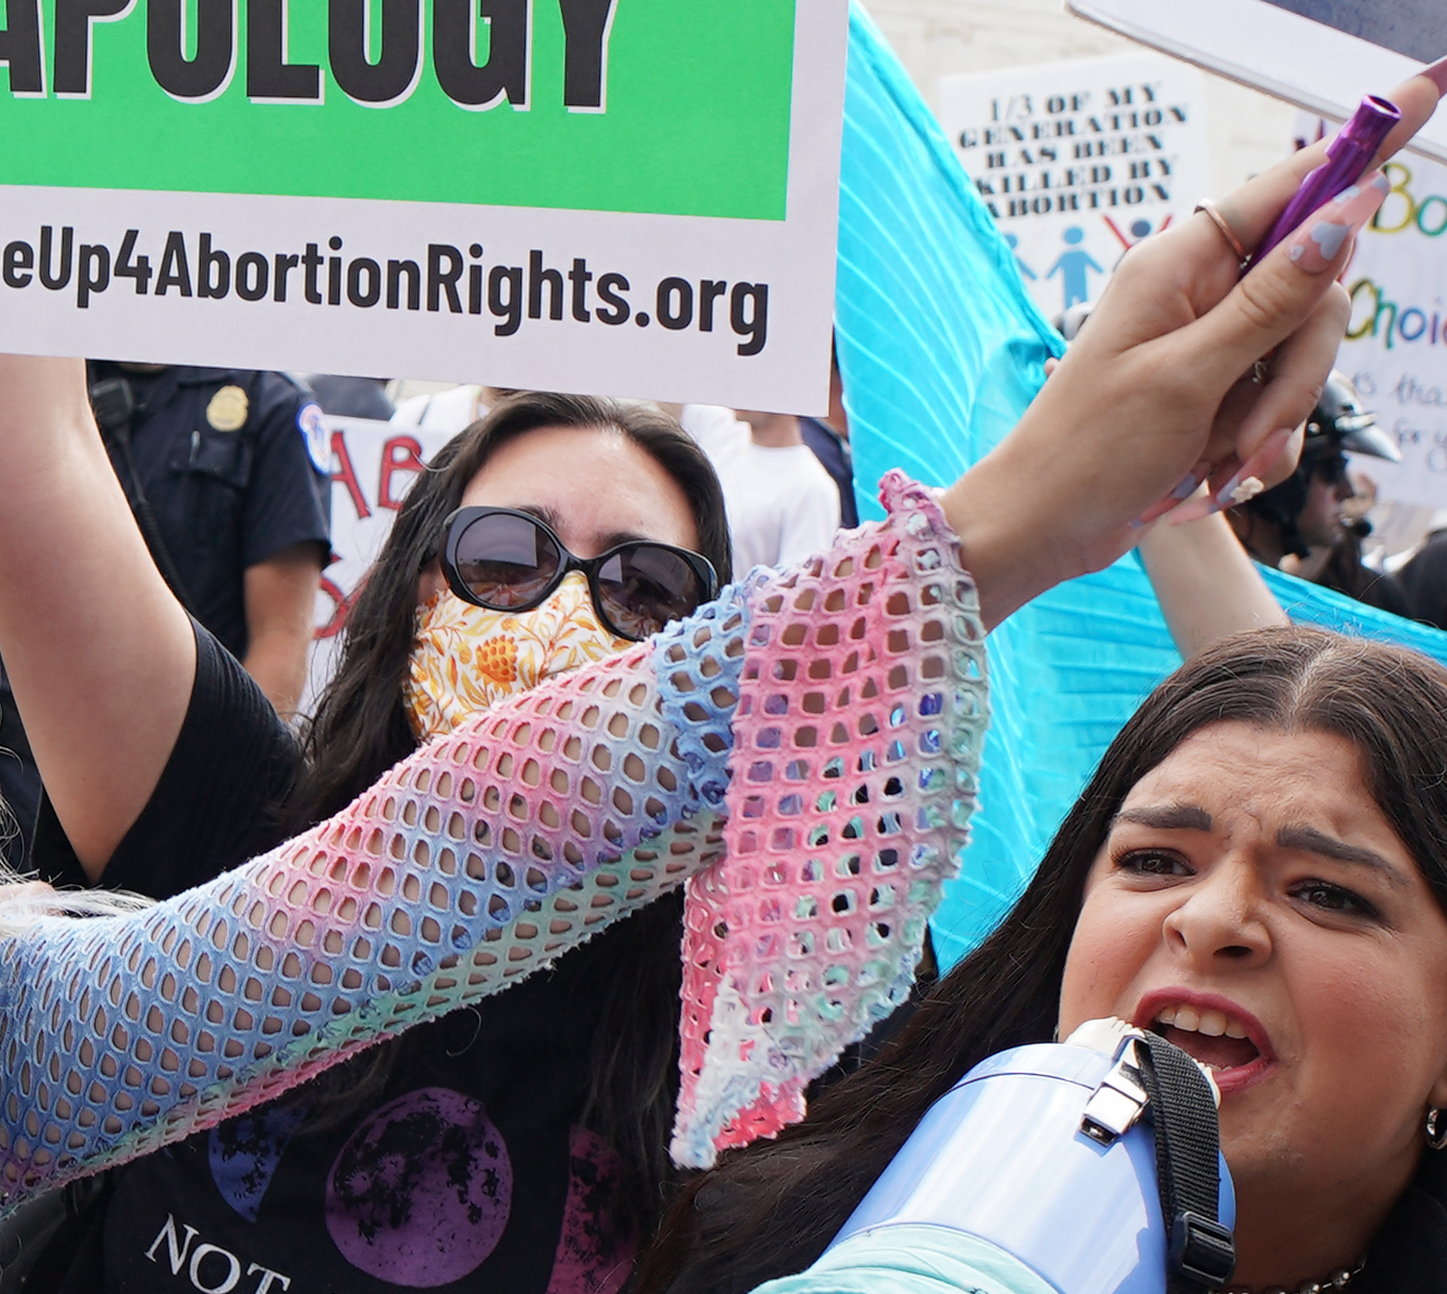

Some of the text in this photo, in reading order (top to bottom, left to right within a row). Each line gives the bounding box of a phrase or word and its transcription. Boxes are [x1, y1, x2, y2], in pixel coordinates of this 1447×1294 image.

[991, 81, 1162, 121] 1/3 OF MY
[959, 104, 1189, 150] GENERATION
[987, 133, 1164, 170] HAS BEEN
[976, 155, 1176, 196] KILLED BY
